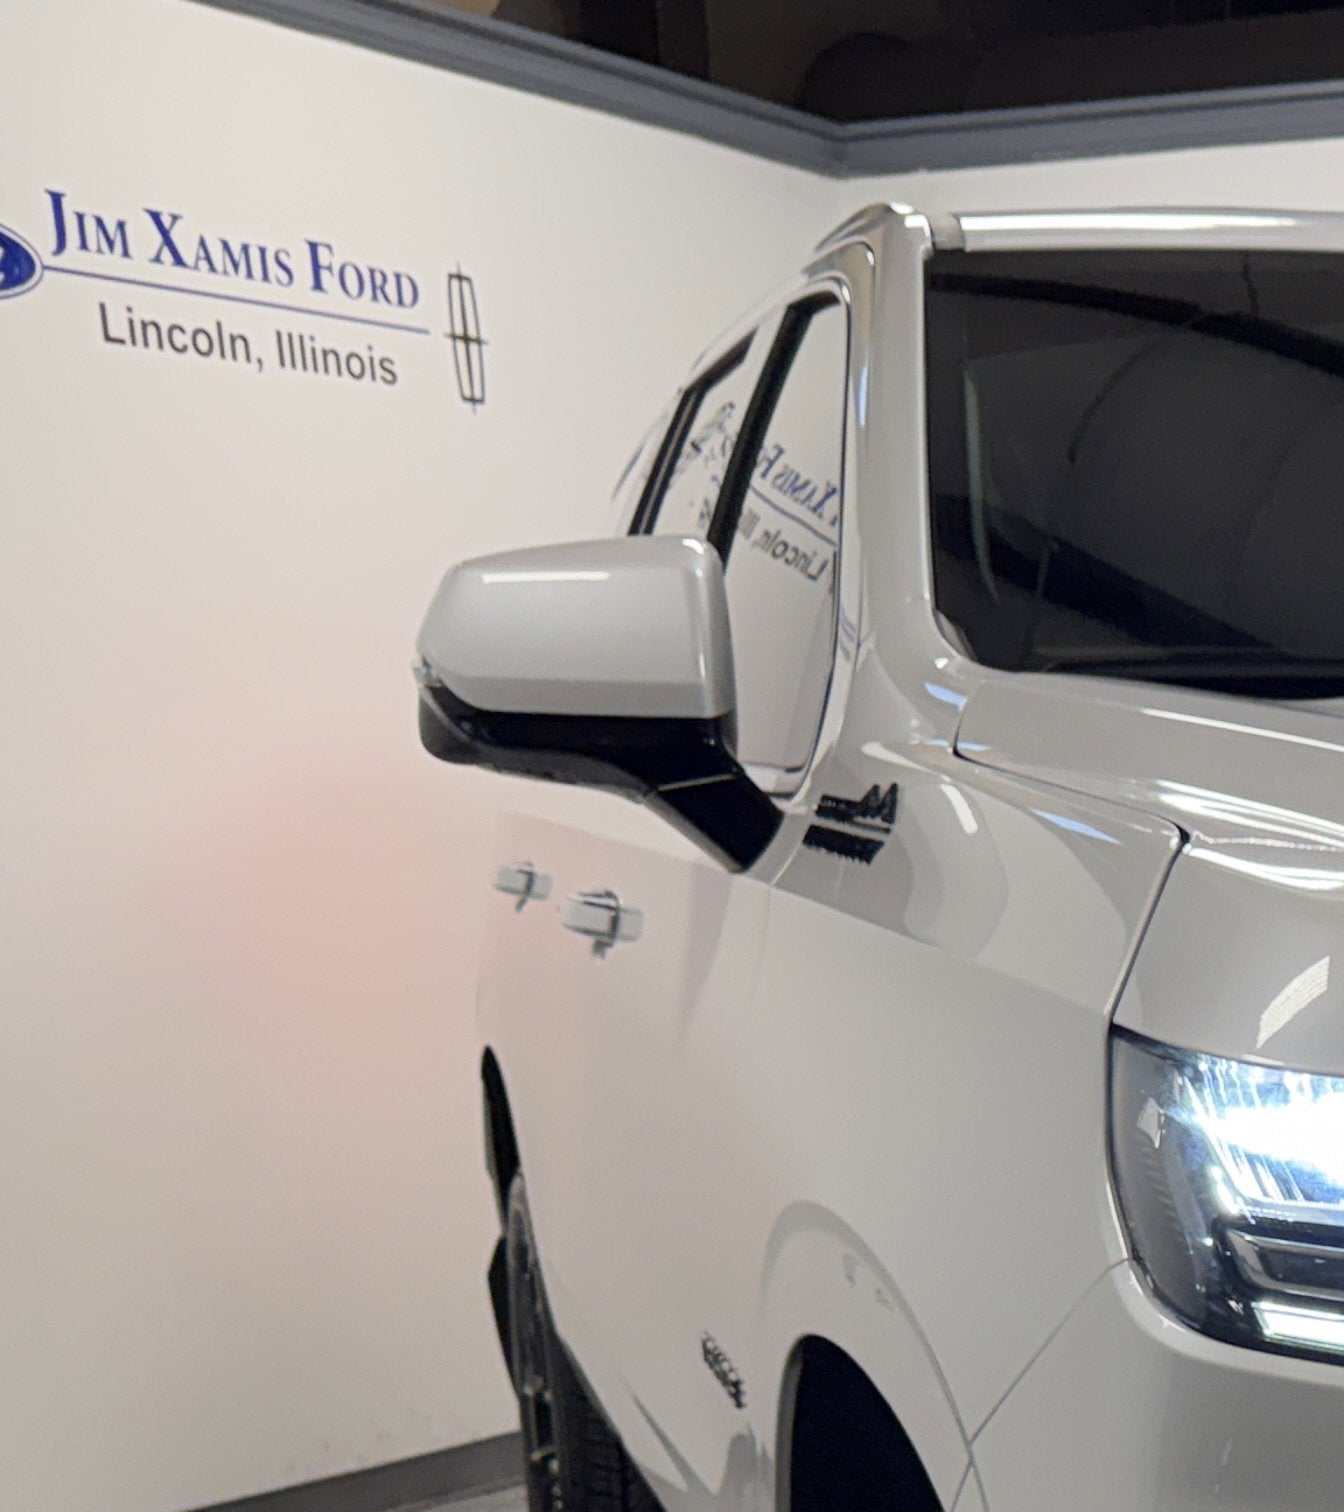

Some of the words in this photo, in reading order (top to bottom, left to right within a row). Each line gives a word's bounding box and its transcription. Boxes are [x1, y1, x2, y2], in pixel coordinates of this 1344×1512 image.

[44, 188, 134, 260] JIM
[142, 208, 295, 288] XAMIS
[304, 238, 420, 310] FORD
[99, 301, 265, 373] Lincoln,
[275, 330, 399, 387] Illinois
